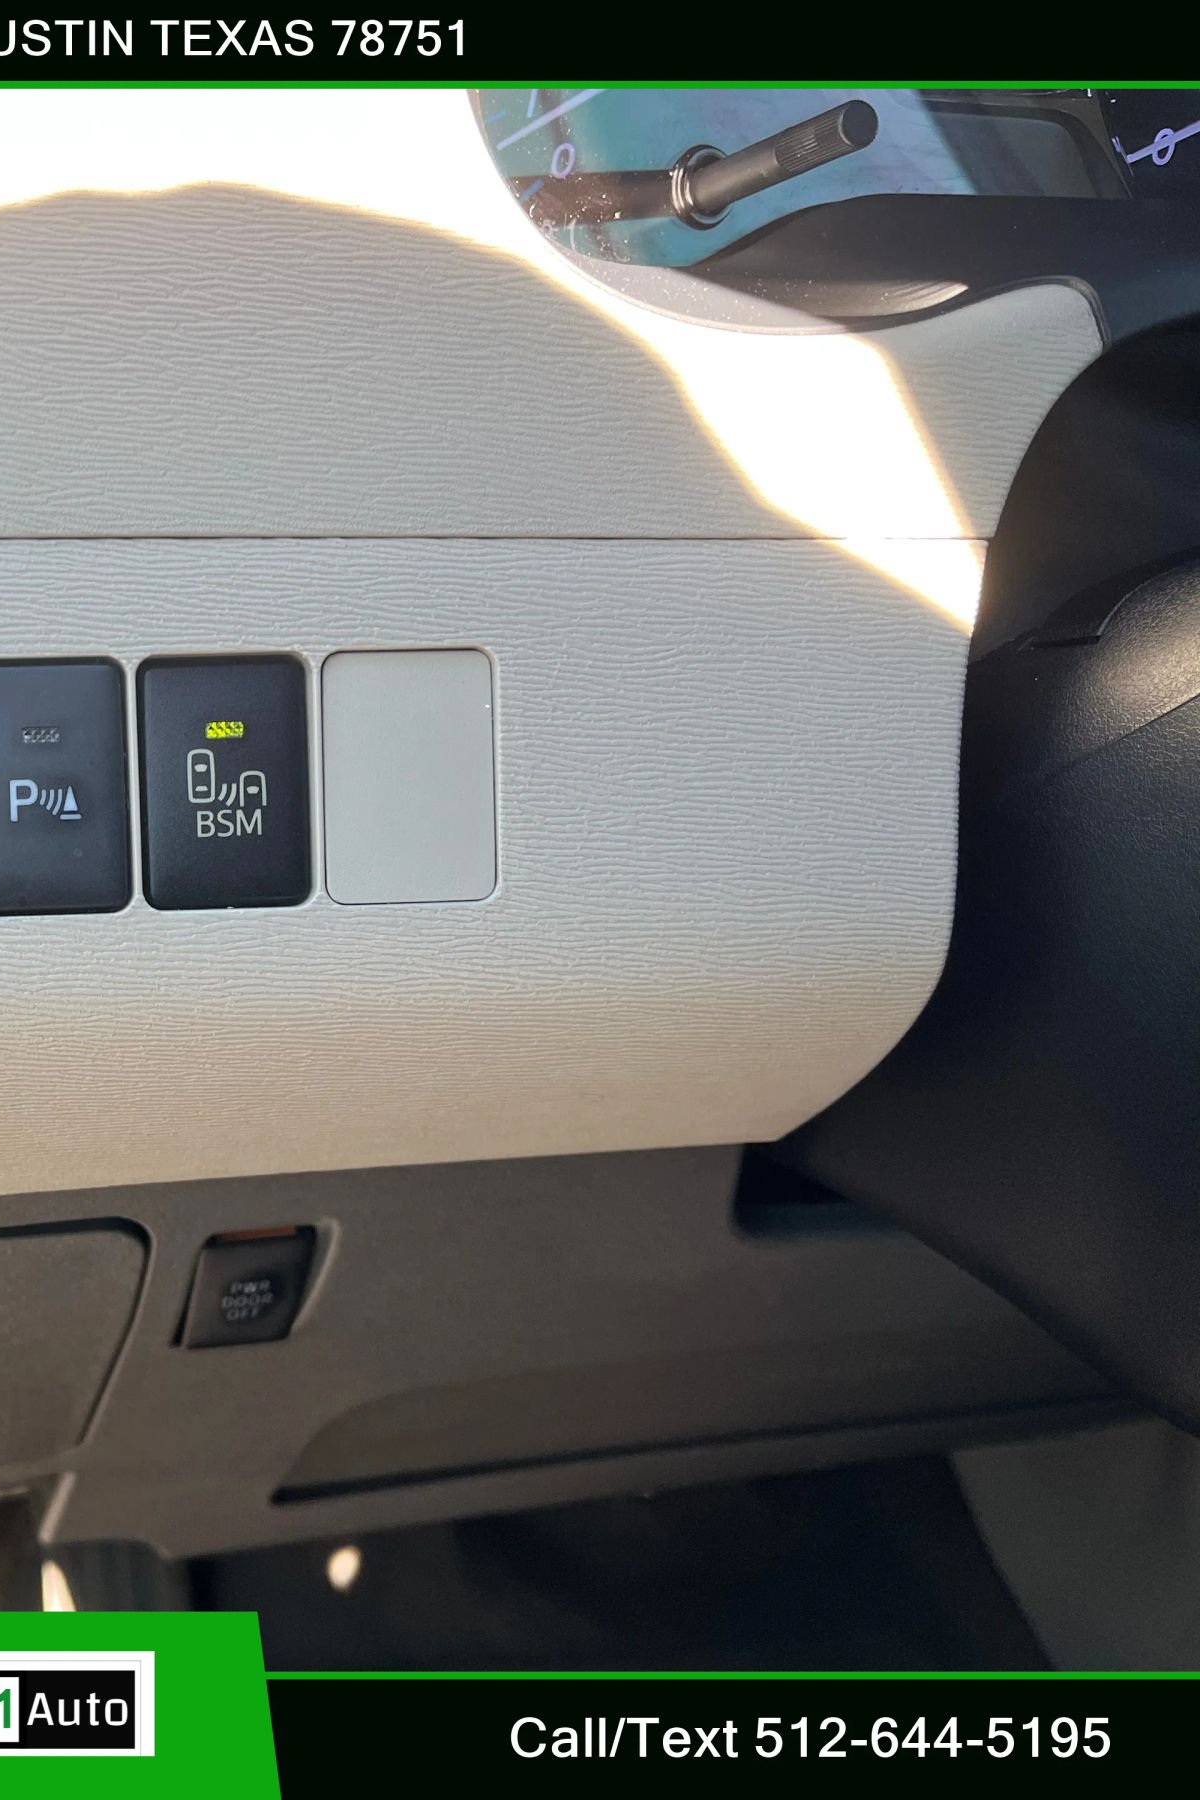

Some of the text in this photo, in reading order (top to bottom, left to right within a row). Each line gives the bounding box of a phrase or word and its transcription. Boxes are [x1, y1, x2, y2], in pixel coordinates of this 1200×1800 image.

[551, 143, 575, 178] 0
[196, 809, 263, 838] BSM
[221, 1292, 273, 1308] DOOR
